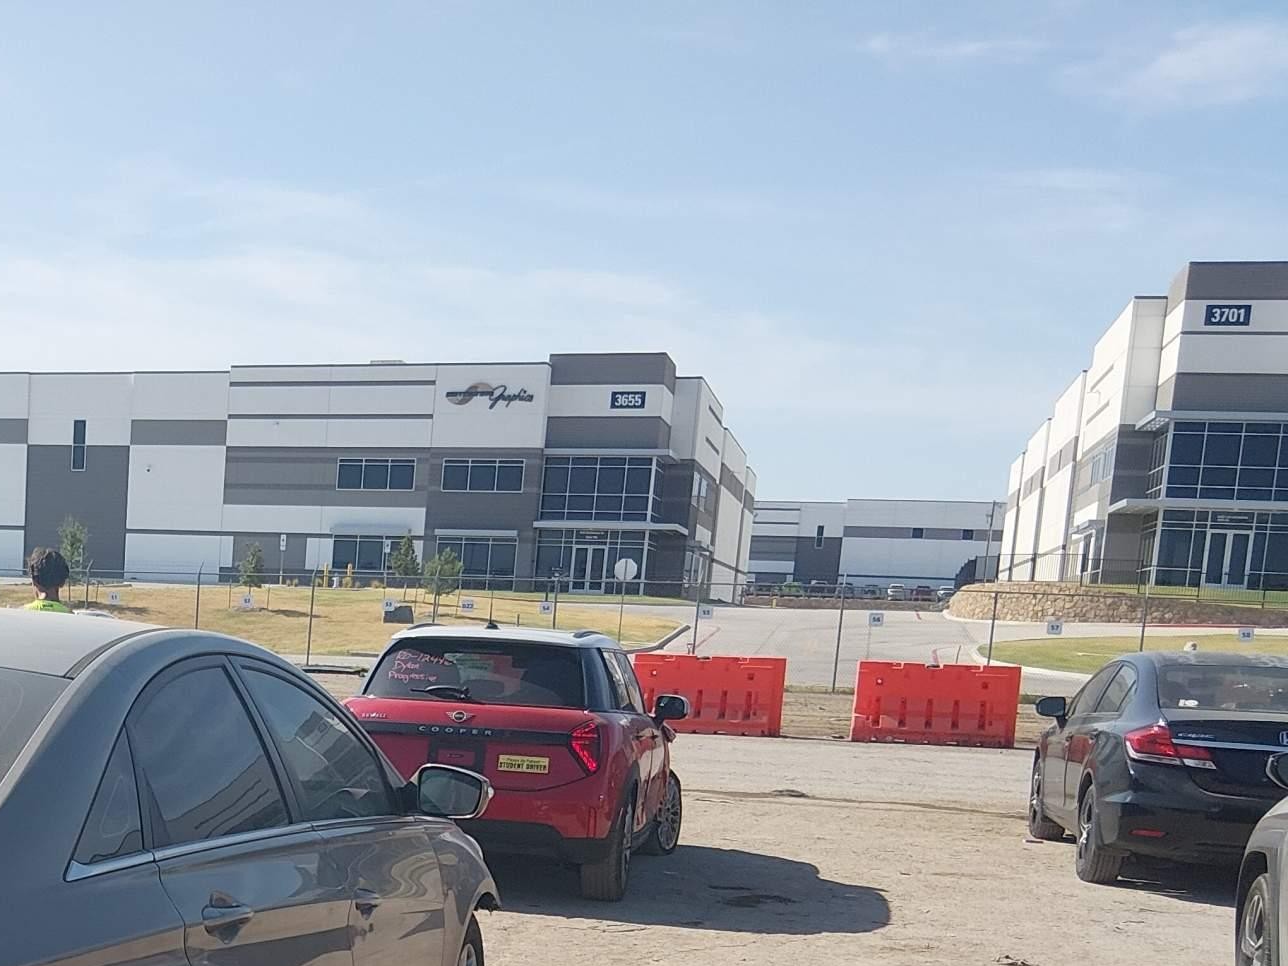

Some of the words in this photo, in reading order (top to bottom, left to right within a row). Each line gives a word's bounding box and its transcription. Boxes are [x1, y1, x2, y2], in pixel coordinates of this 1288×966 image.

[1211, 308, 1245, 322] 3701
[614, 394, 642, 406] 3655
[418, 725, 493, 736] COOPER
[499, 761, 524, 769] STUDENT
[526, 763, 546, 771] DRIVER
